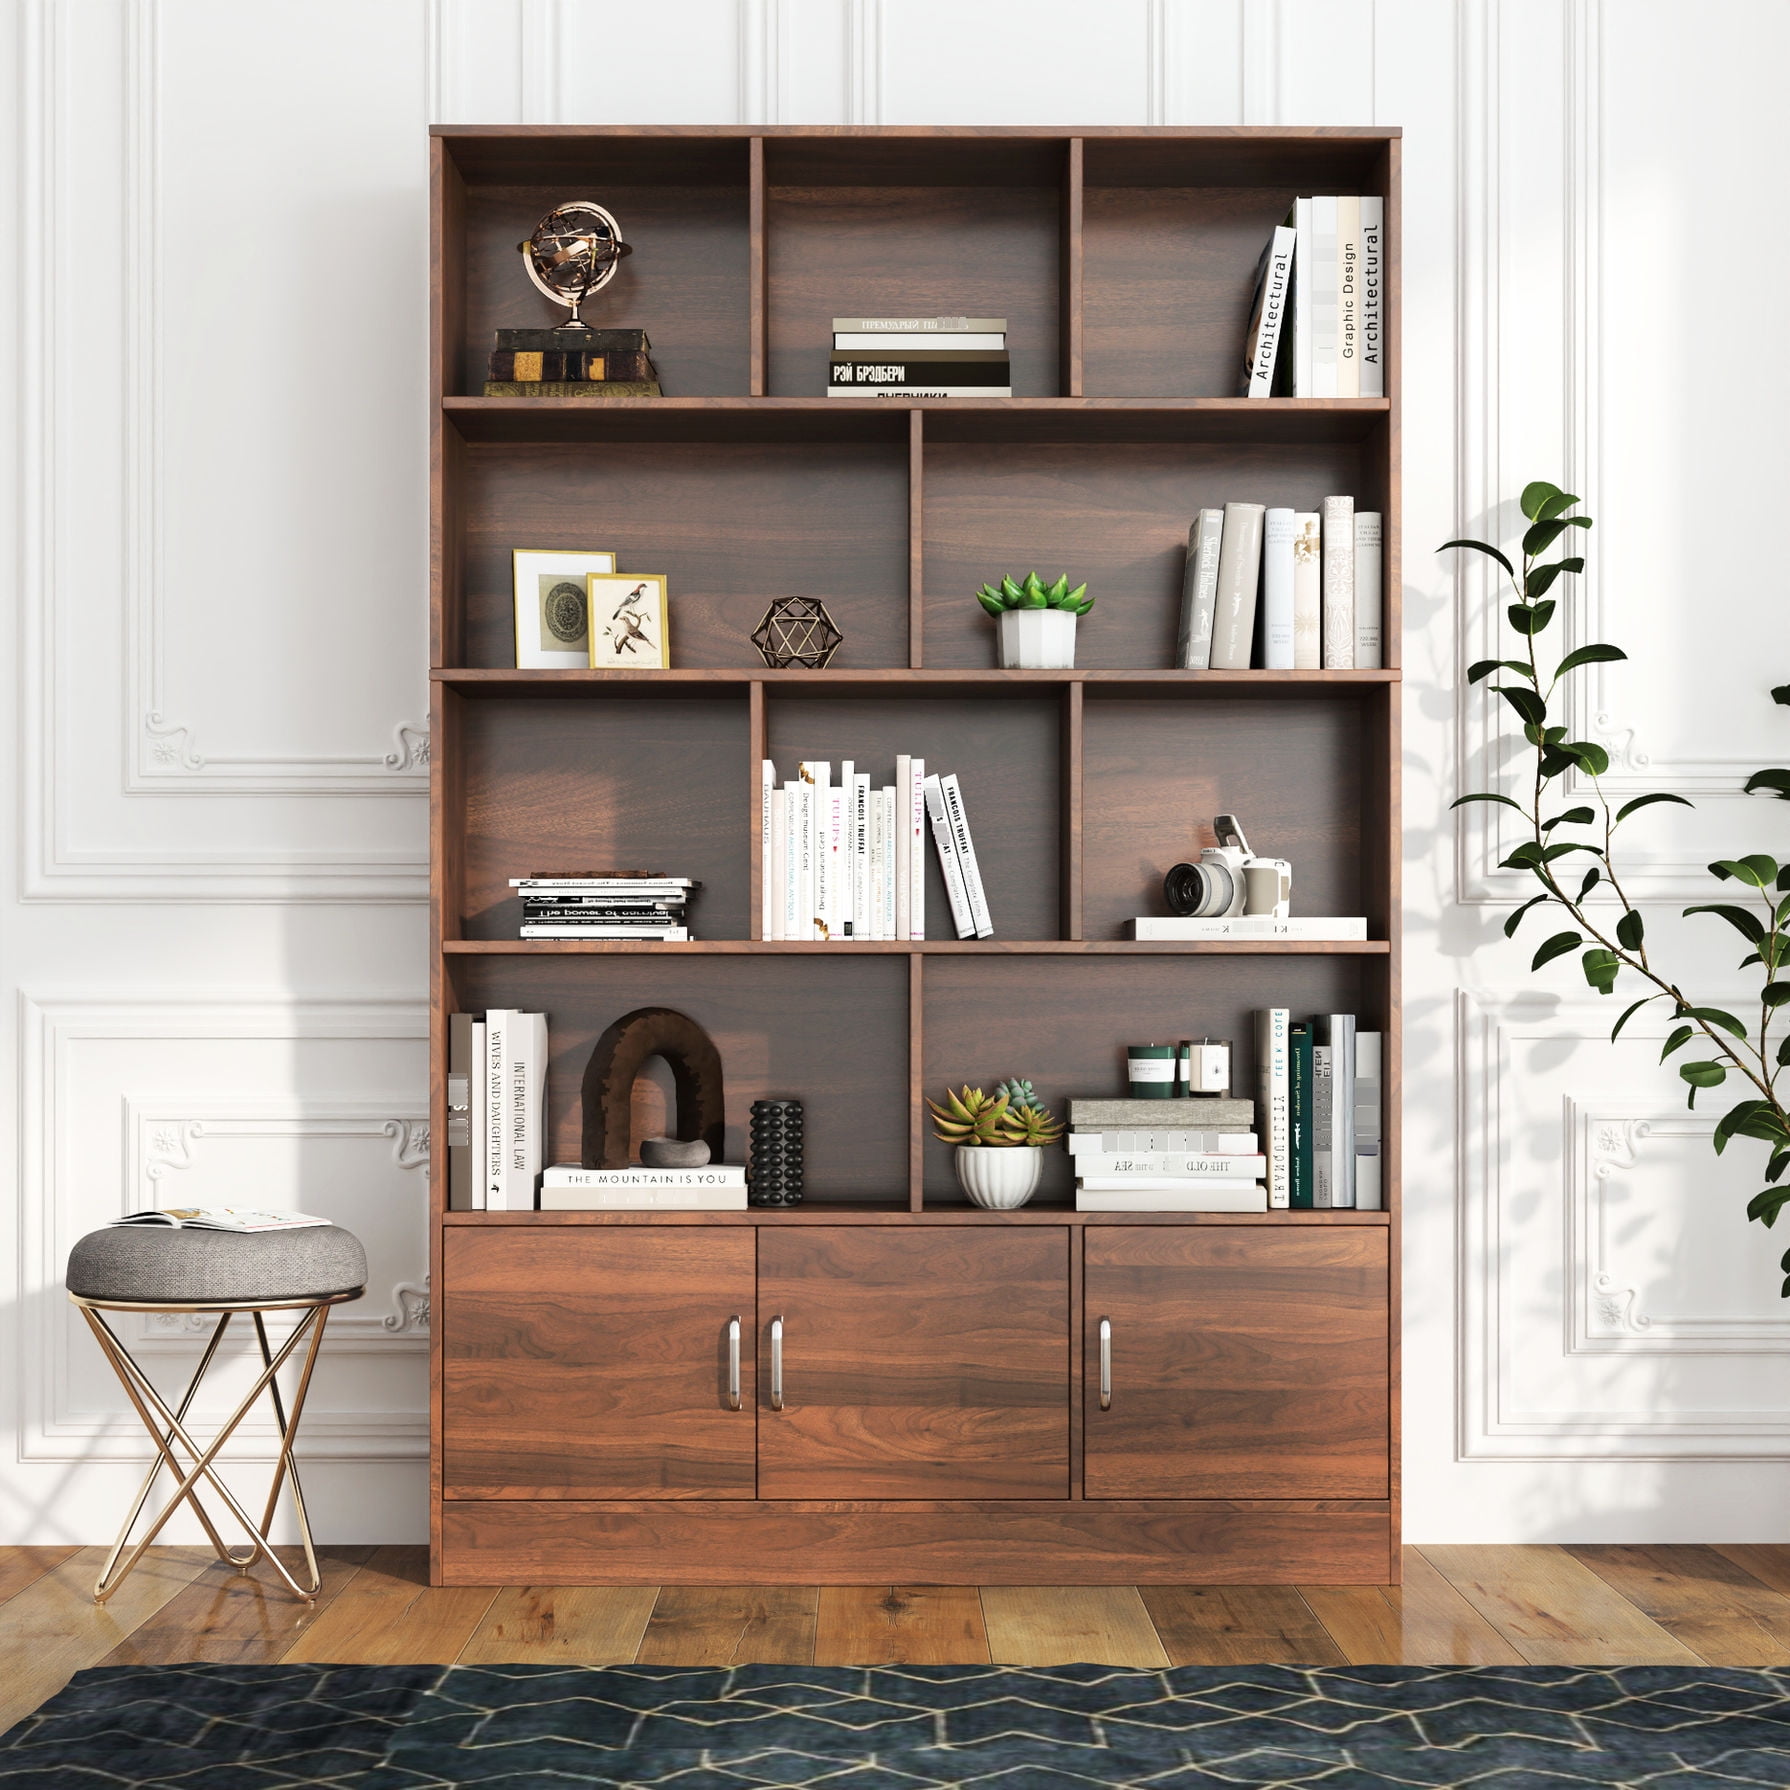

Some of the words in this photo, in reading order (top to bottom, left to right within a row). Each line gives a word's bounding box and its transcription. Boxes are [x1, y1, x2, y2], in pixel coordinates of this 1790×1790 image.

[1343, 243, 1356, 294] Design
[1364, 225, 1378, 364] Architectural
[1256, 253, 1288, 380] Architectural
[1343, 301, 1355, 359] Graphic
[834, 363, 852, 382] РЭЙ
[856, 365, 905, 383] БРЭДБЕРИ
[1200, 536, 1218, 569] Sherlock
[1198, 571, 1214, 599] Holmes
[491, 1031, 501, 1070] WIVES
[491, 1072, 501, 1099] AND
[514, 1062, 525, 1145] INTERNATIONAL
[491, 1101, 501, 1176] DAUGHTERS
[514, 1148, 525, 1170] LAW
[568, 1175, 591, 1184] THE
[598, 1175, 674, 1184] MOUNTAIN
[680, 1175, 692, 1184] IS
[697, 1174, 728, 1184] YOU
